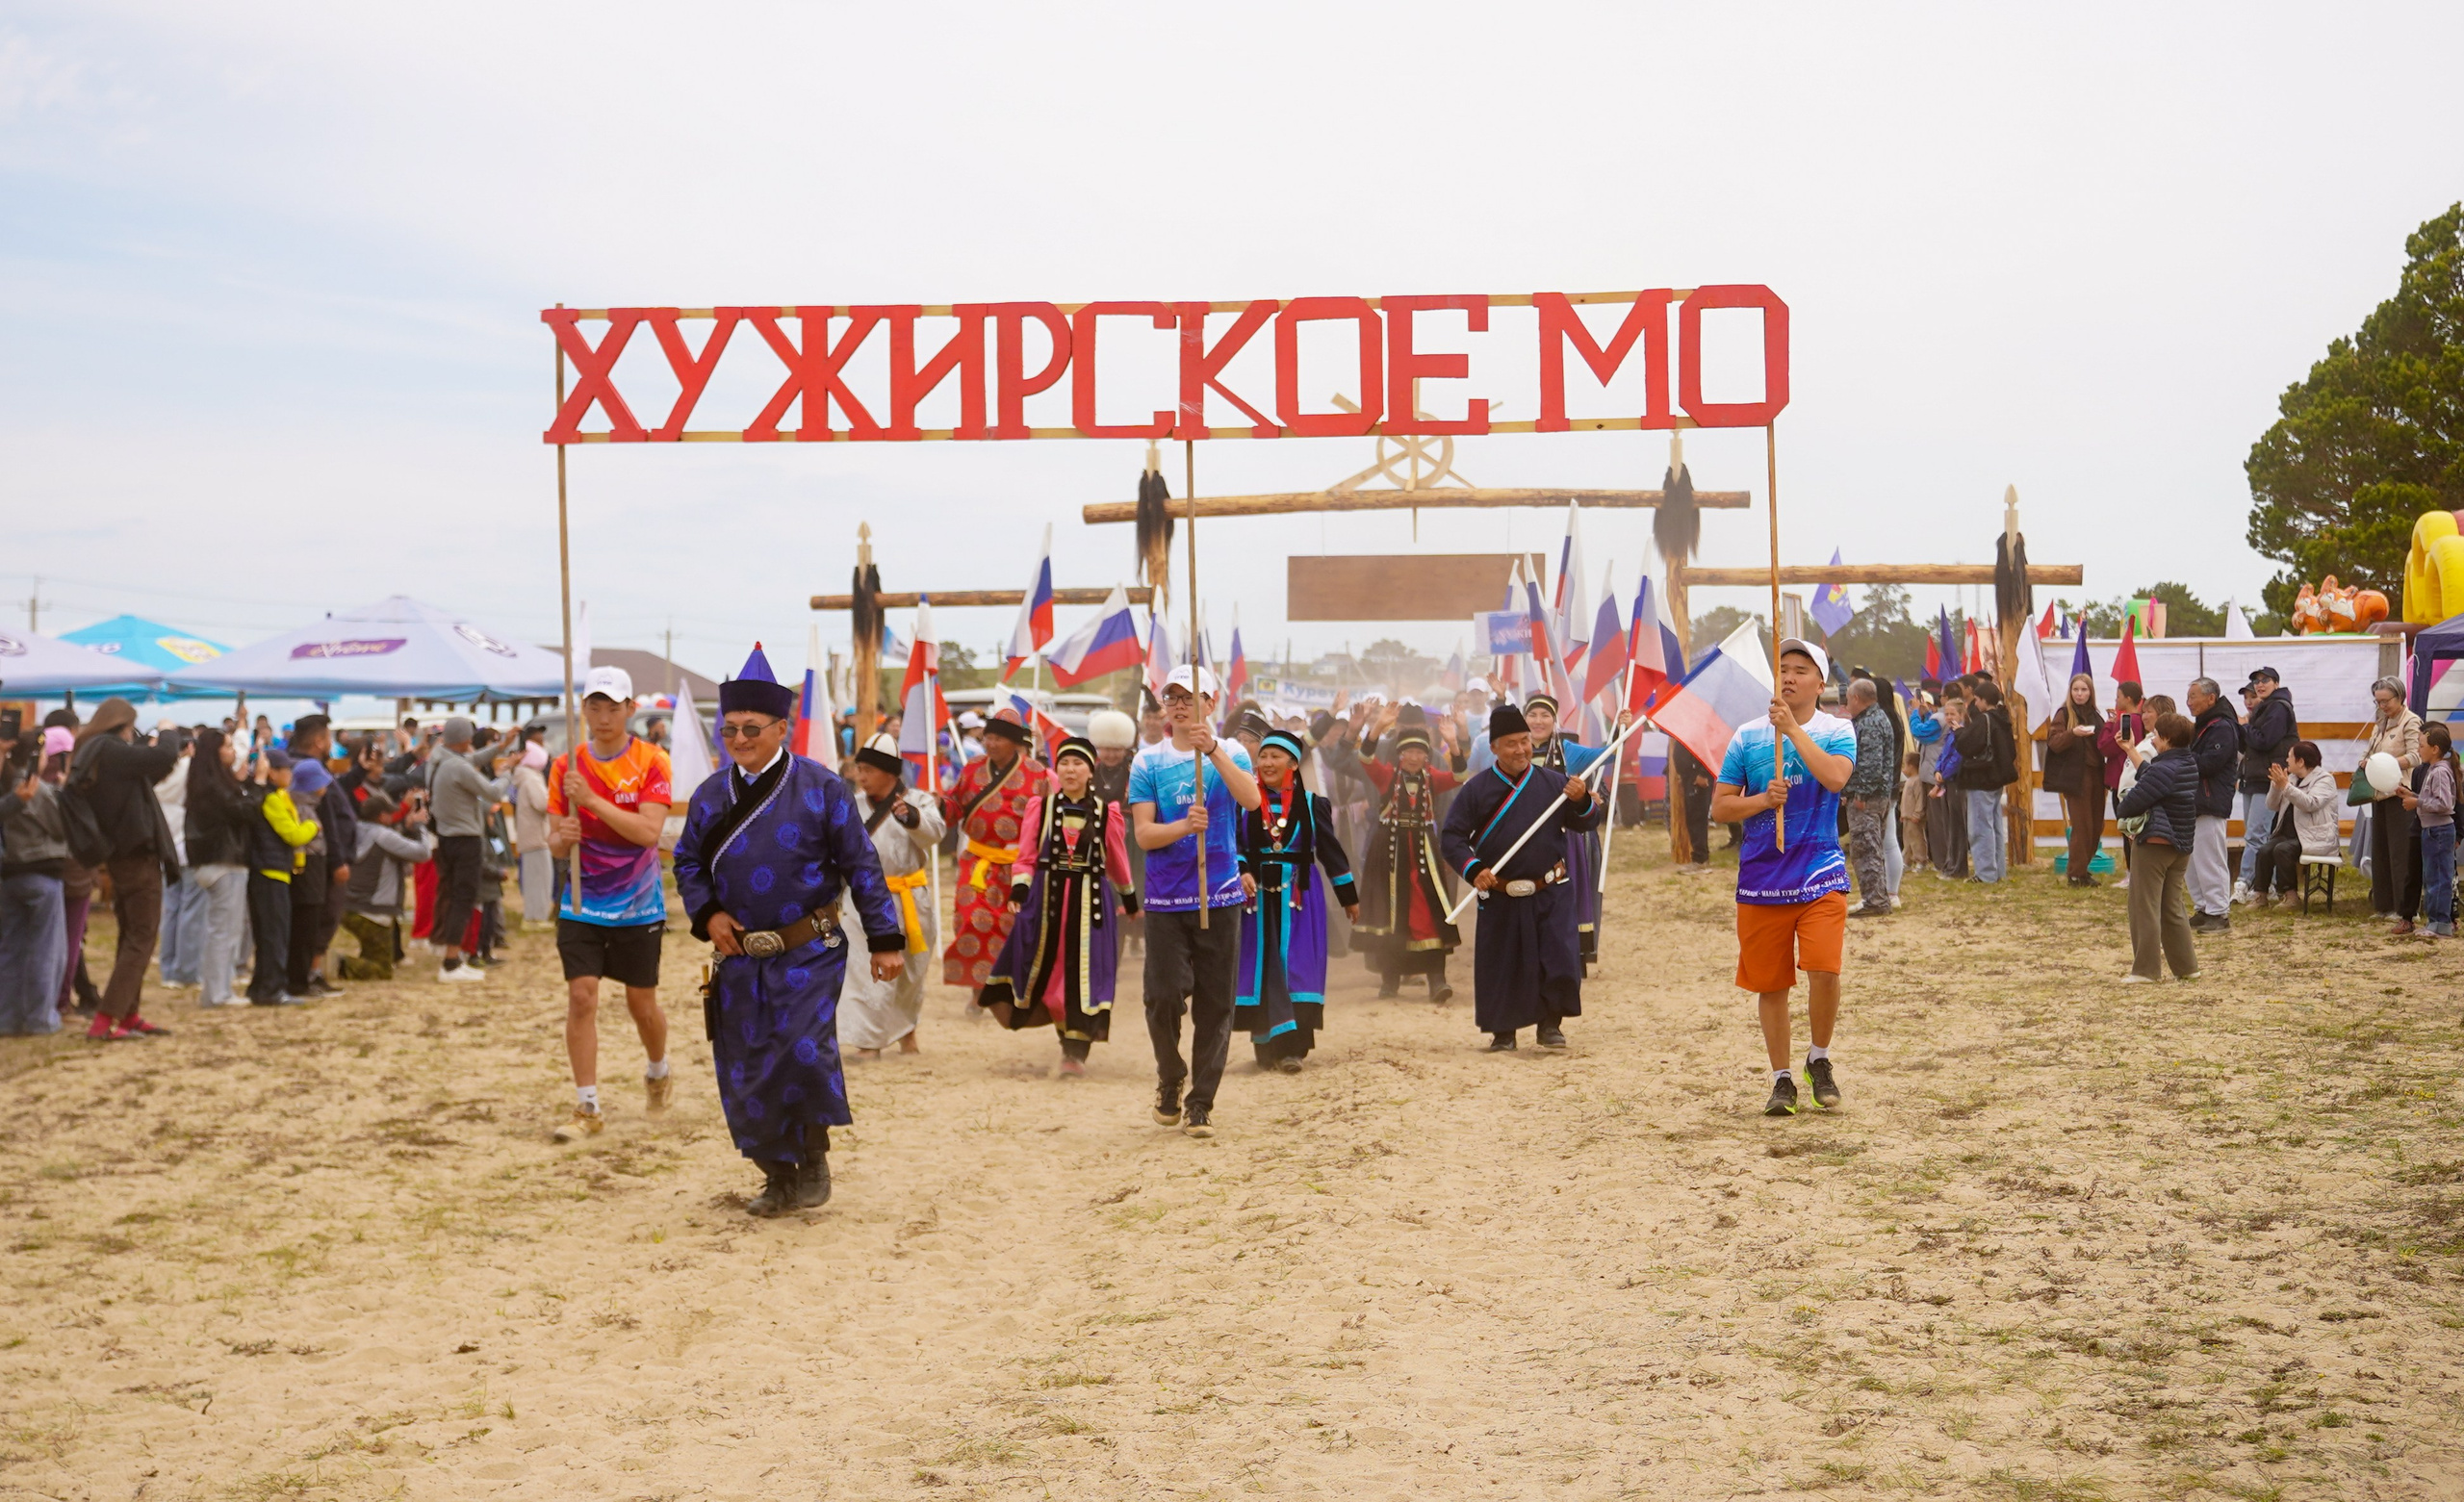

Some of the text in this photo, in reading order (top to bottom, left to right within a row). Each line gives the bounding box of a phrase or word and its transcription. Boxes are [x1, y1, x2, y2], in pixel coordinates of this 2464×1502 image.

[541, 284, 1789, 445] ХУЖИРСКОЕ МО
[1176, 792, 1207, 804] ОЛЬХН
